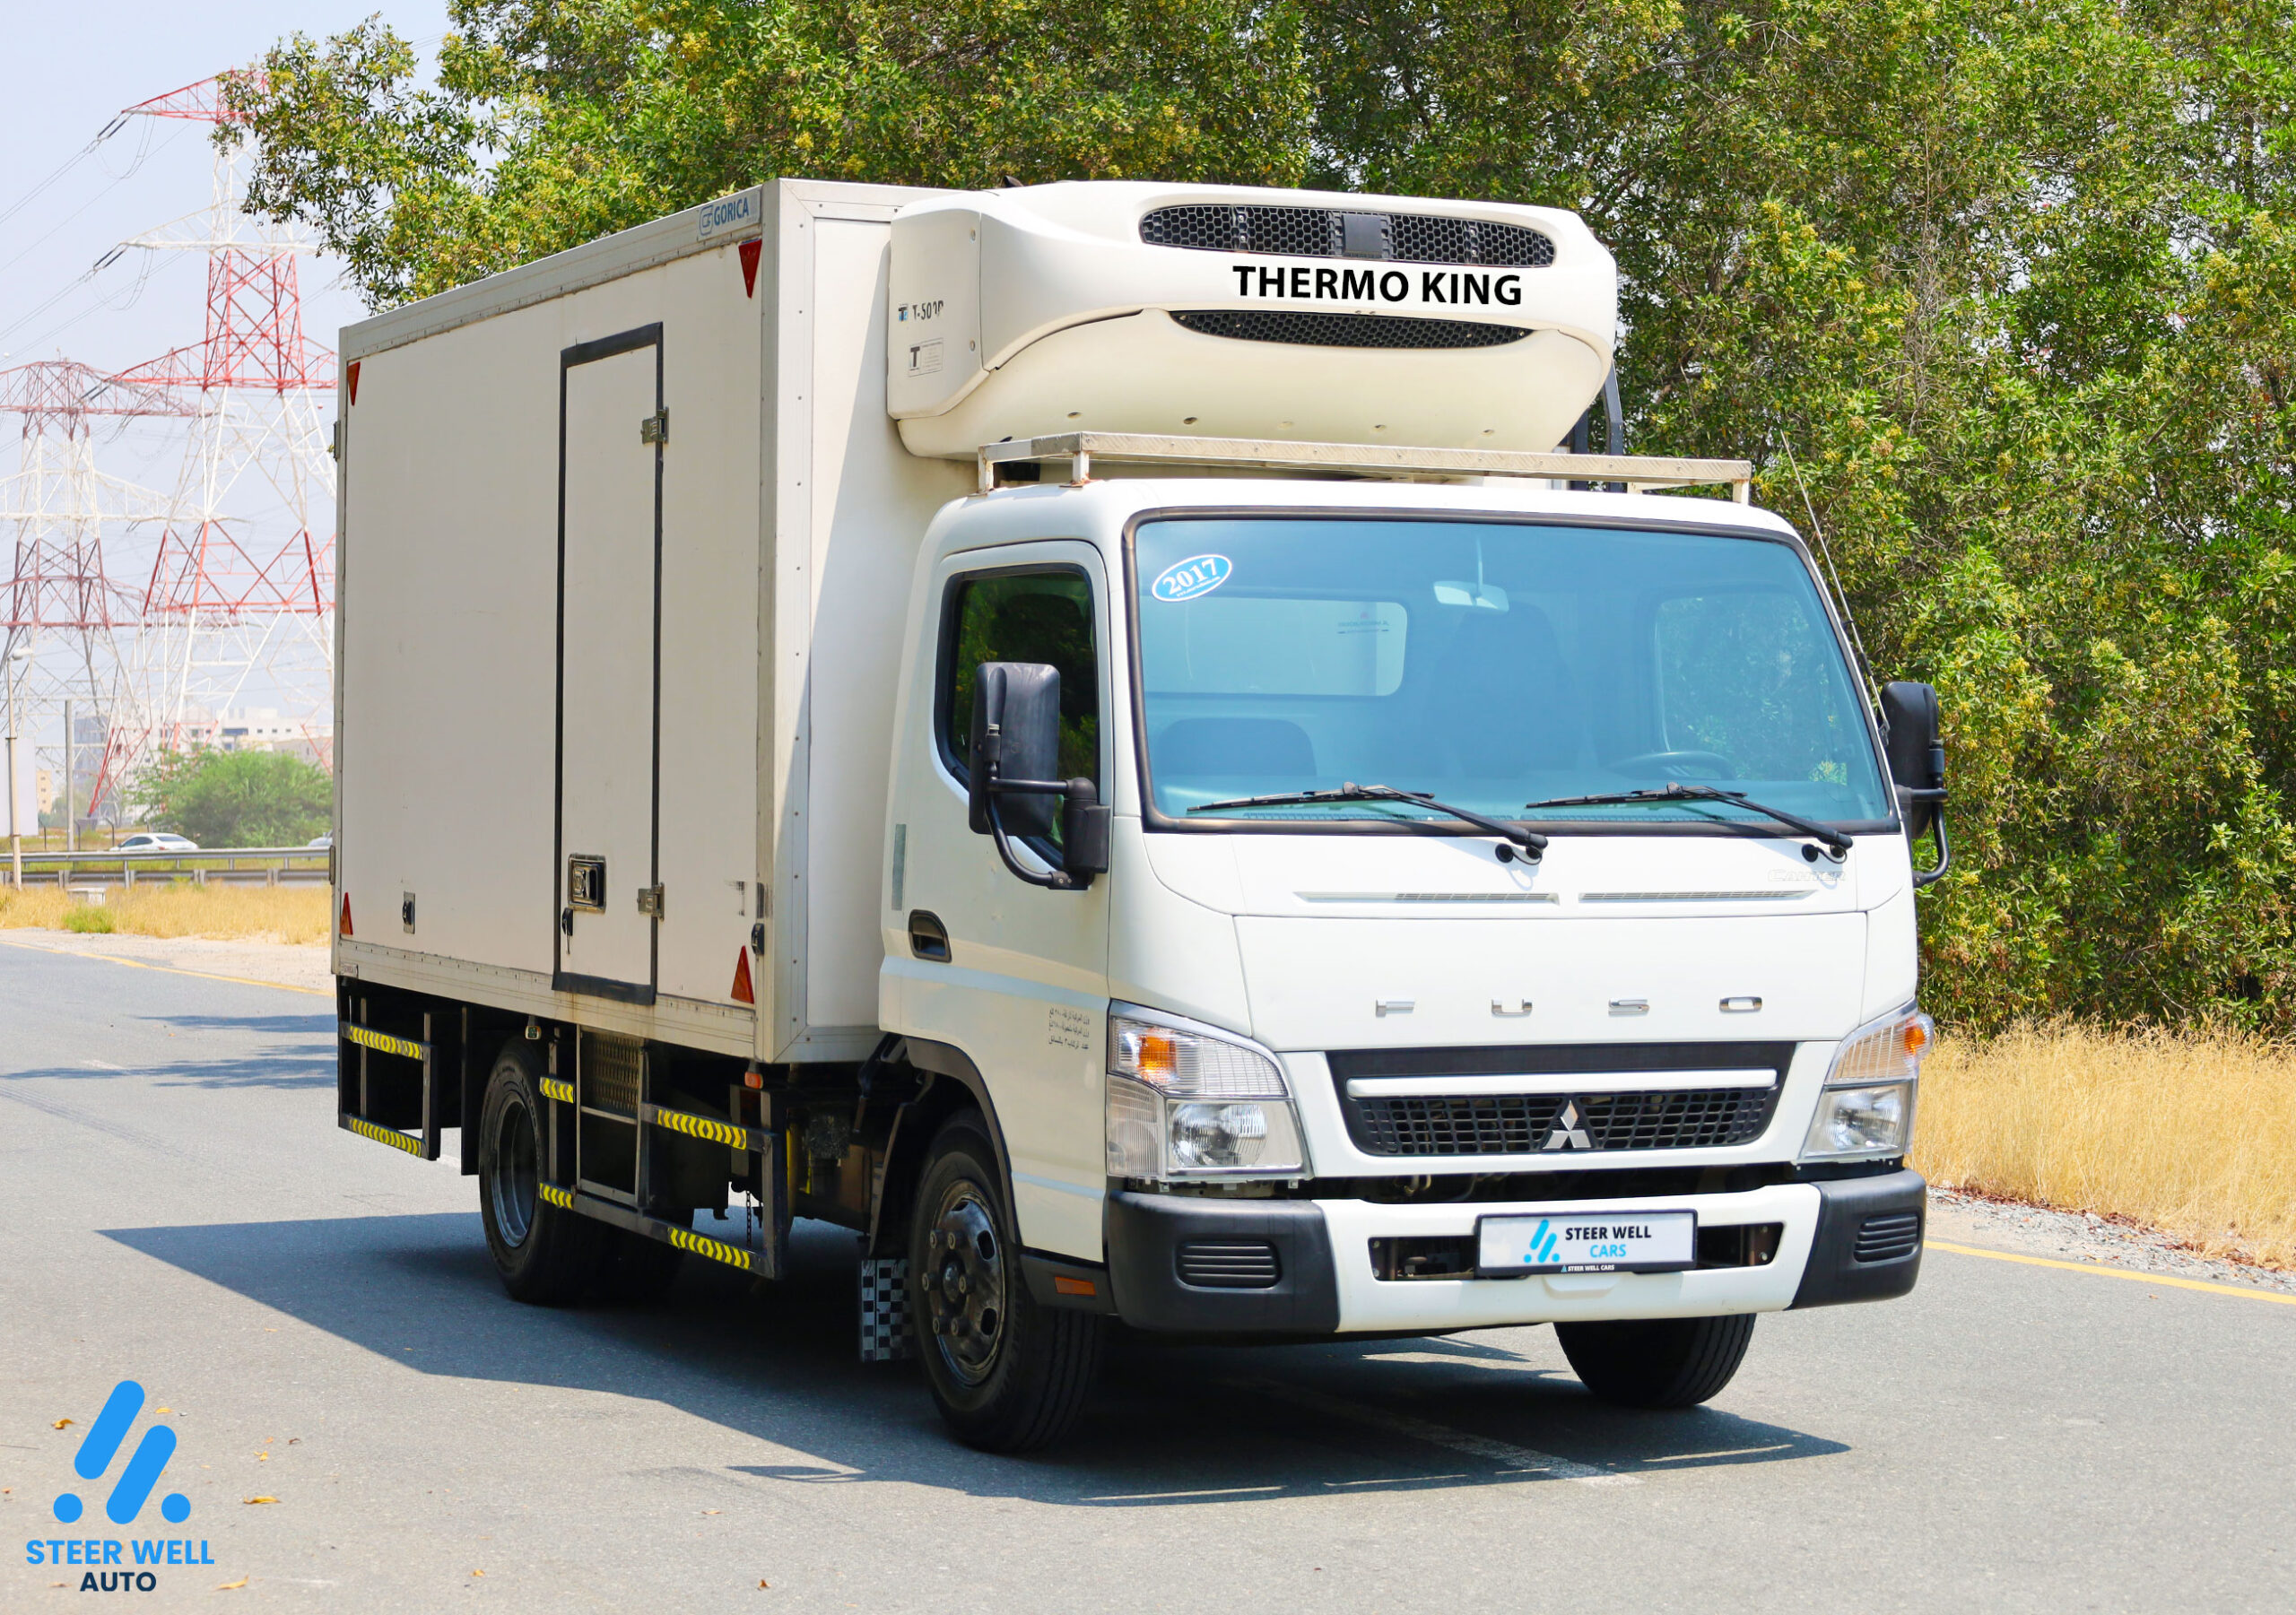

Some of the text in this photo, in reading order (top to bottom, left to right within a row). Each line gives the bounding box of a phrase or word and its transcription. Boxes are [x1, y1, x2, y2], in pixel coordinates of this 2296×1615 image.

[714, 196, 750, 226] GORICA
[1232, 265, 1522, 306] THERMO KING
[1162, 558, 1217, 595] 2017
[1565, 1225, 1652, 1241] STEER WELL
[1589, 1244, 1627, 1258] CARS
